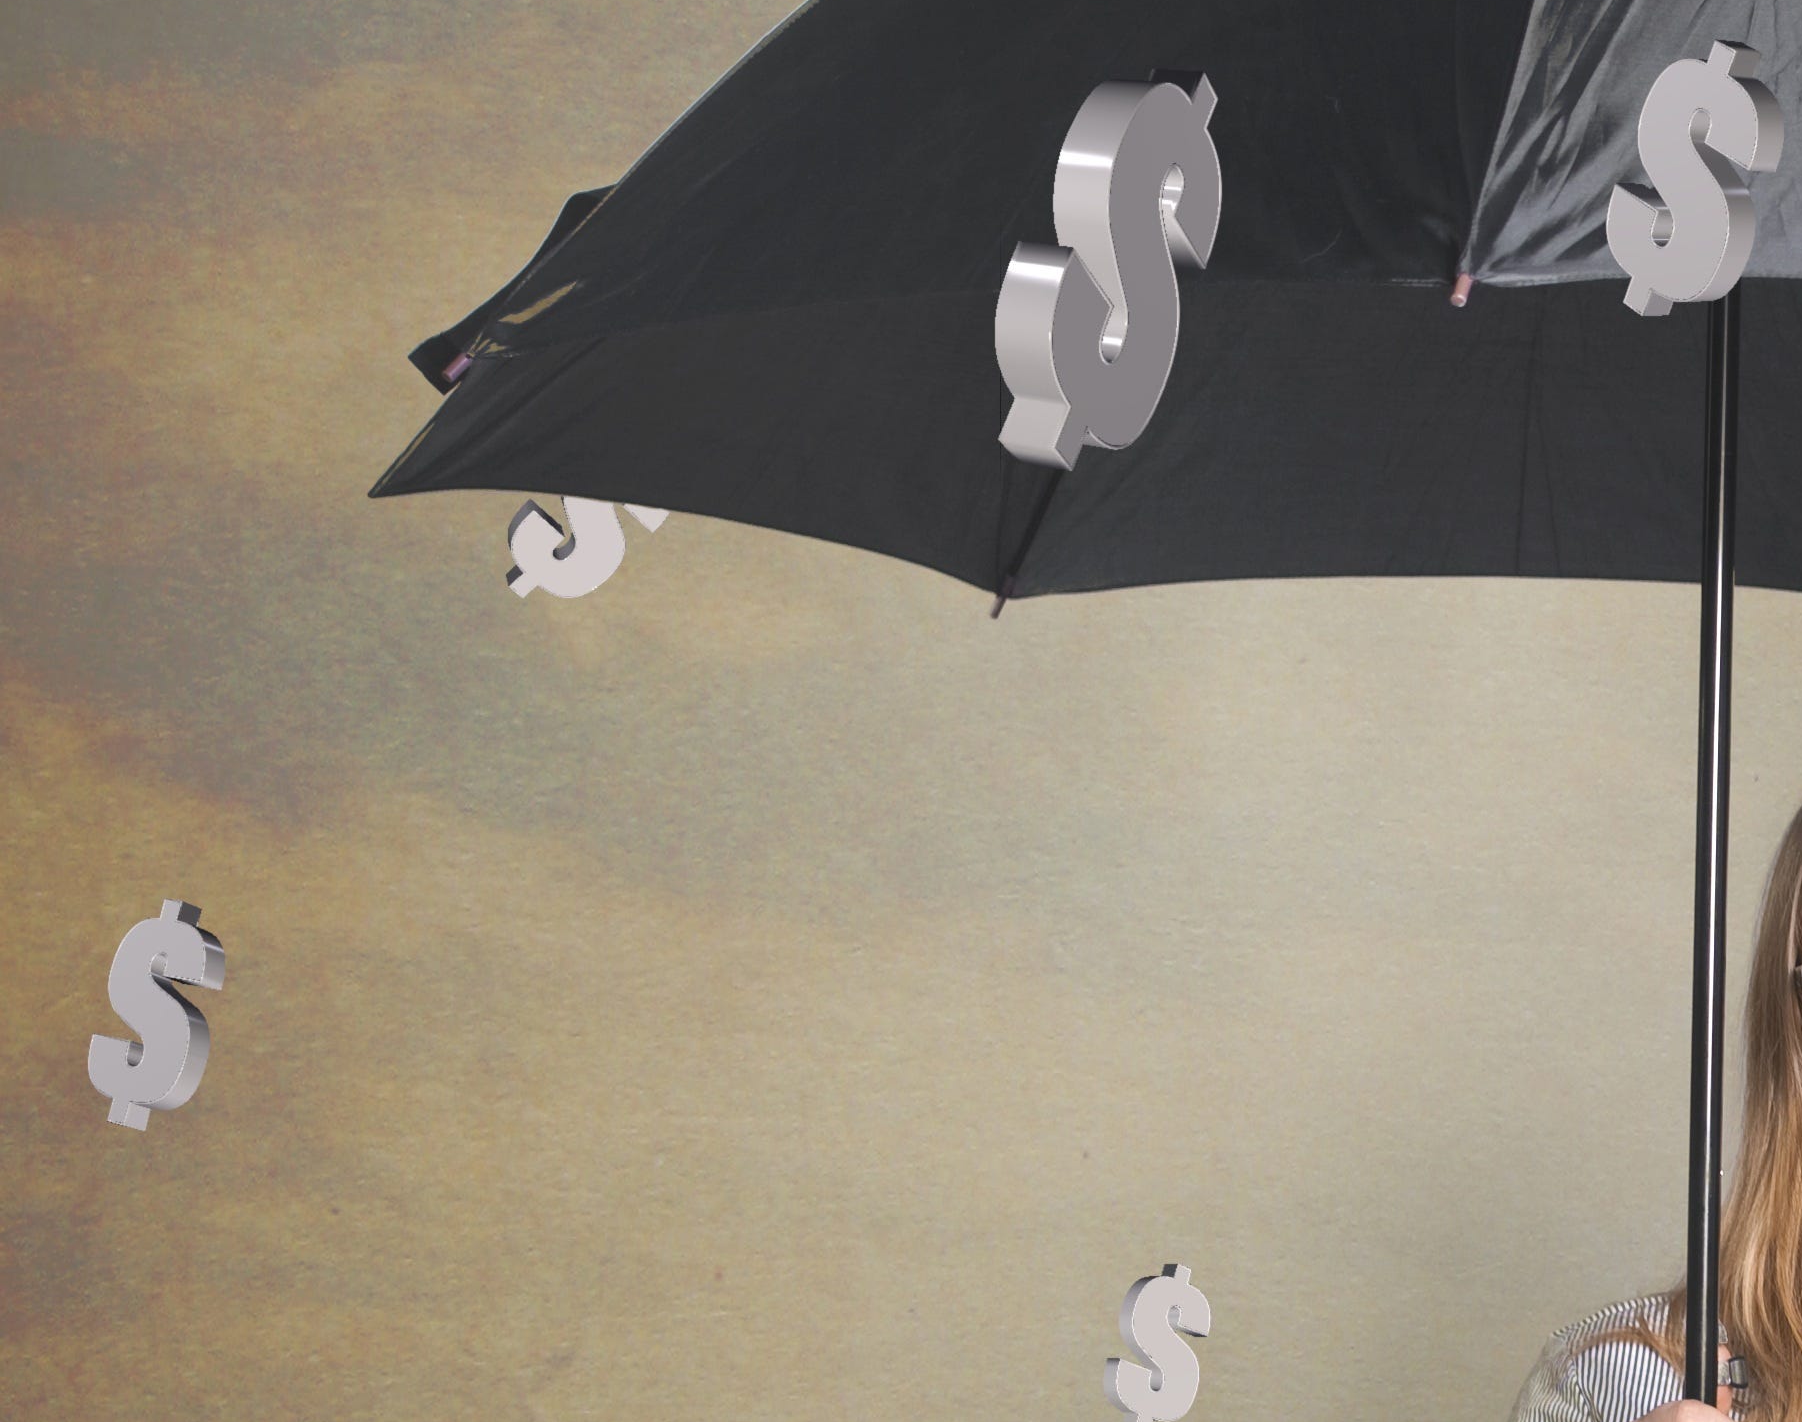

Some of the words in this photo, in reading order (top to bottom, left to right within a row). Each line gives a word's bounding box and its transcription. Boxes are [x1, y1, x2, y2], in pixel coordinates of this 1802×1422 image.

[995, 68, 1222, 472] $
[1607, 39, 1784, 317] $
[87, 898, 227, 1131] $
